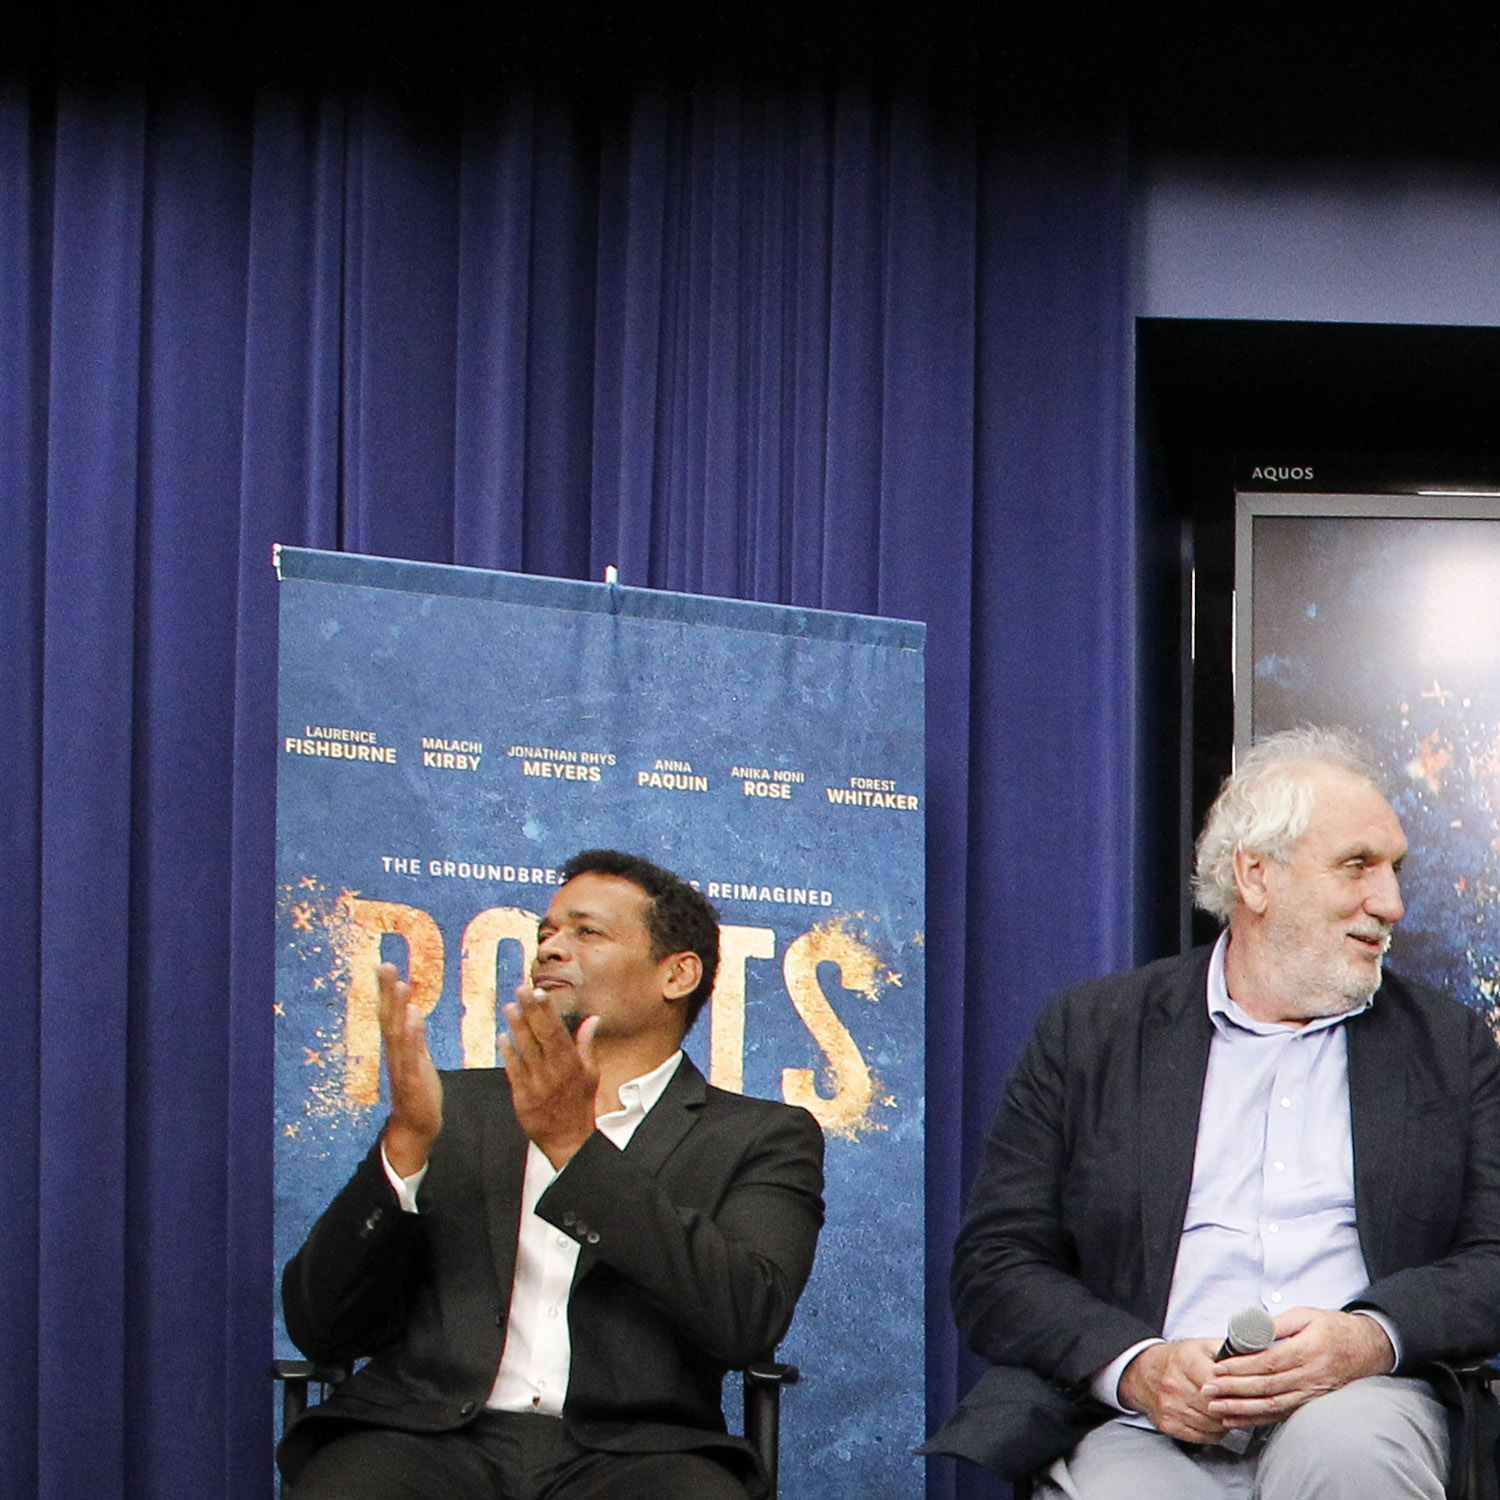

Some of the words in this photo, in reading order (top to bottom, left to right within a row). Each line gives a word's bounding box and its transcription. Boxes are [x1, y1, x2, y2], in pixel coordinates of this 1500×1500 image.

[1252, 467, 1314, 482] AQUOS
[305, 725, 377, 745] LAURENCE
[285, 737, 397, 765] FISHBURNE
[422, 737, 483, 754] MALACHI
[507, 745, 577, 763] JONATHAN
[581, 752, 617, 766] RHYS
[423, 752, 481, 771] KIRBY
[523, 760, 601, 782] MEYERS
[654, 759, 692, 773] ANNA
[637, 771, 708, 792] PAQUIN
[731, 765, 770, 781] ANIKA
[774, 770, 805, 783] NONI
[743, 781, 792, 799] ROSE
[850, 777, 896, 792] FOREST
[826, 788, 919, 811] WHITAKER
[381, 855, 421, 876] THE
[429, 859, 567, 886] GROUNDBRE
[707, 880, 833, 908] REIMAGINED
[345, 898, 872, 1138] RTS
